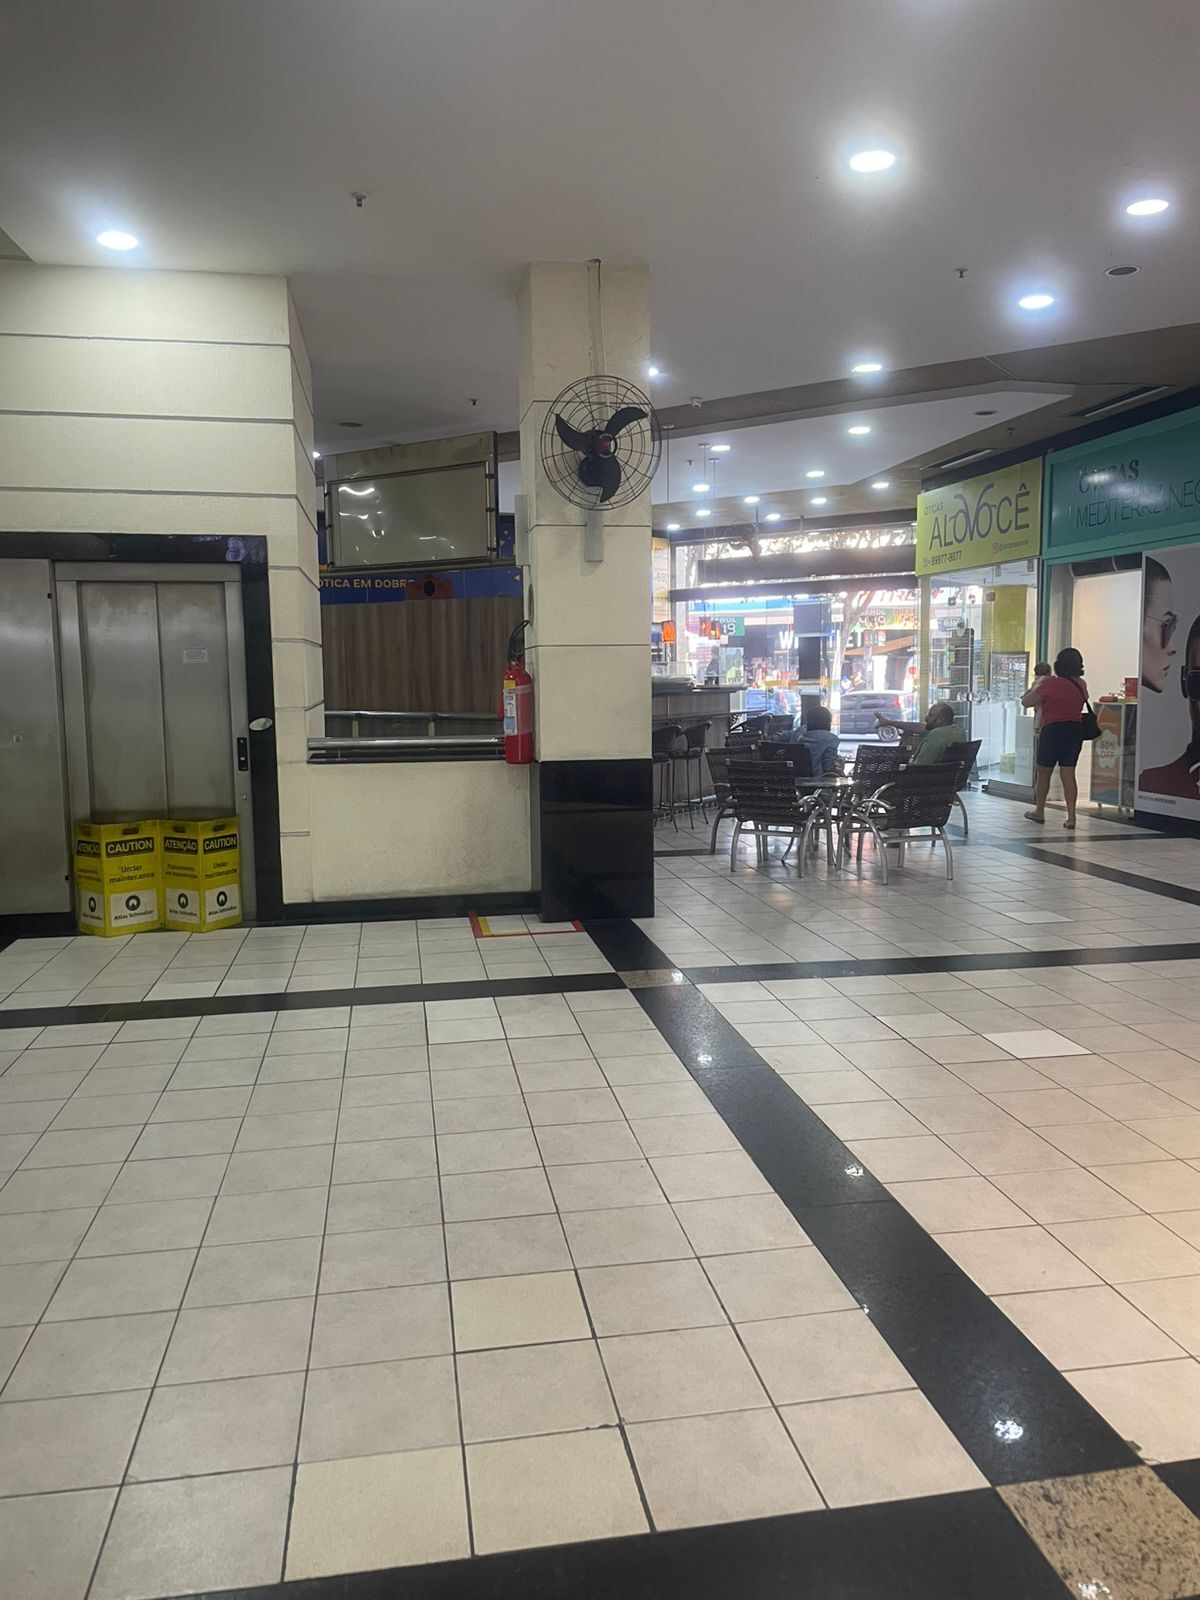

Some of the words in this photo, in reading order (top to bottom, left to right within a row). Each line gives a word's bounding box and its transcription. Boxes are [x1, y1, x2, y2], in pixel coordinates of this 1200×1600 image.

[353, 579, 371, 588] EM
[374, 579, 415, 588] DOBR
[107, 839, 153, 854] CAUTION
[164, 839, 197, 851] ATENÇÃO
[204, 836, 237, 850] CAUTION
